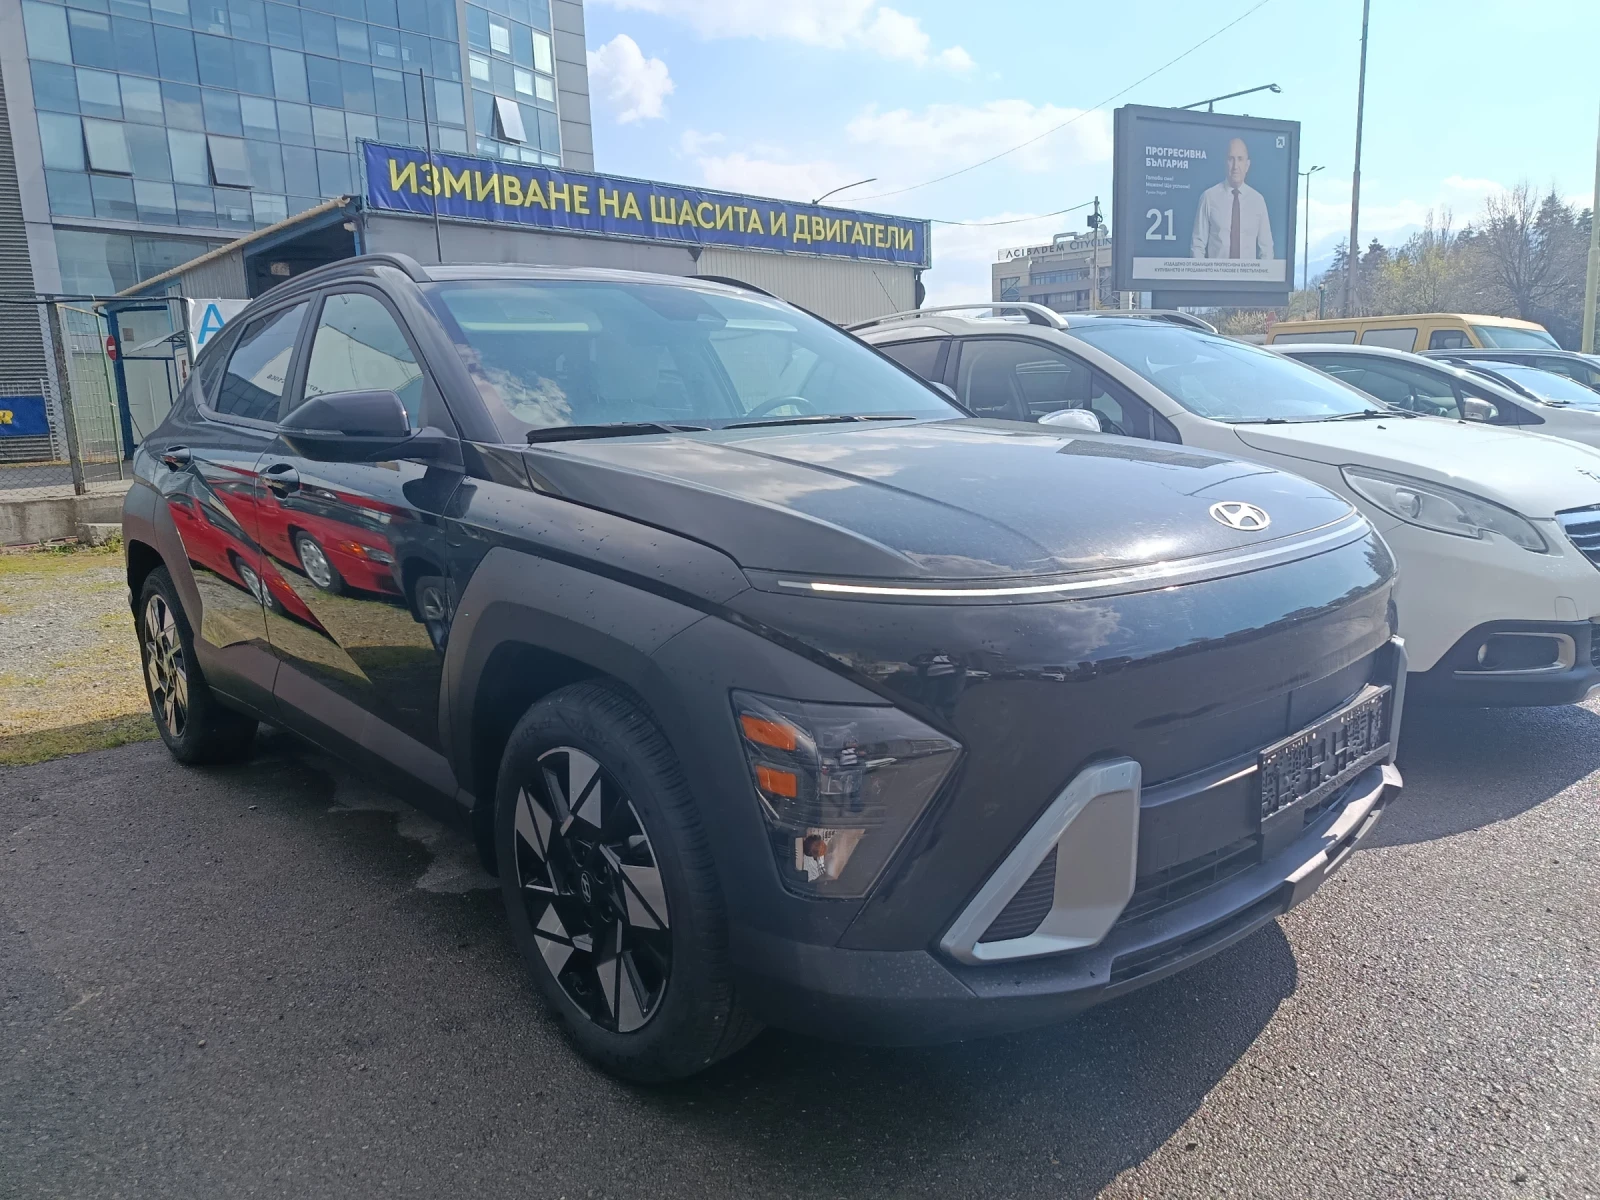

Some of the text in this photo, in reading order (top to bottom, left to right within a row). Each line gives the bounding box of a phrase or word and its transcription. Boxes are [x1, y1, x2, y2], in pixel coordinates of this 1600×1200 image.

[1145, 146, 1207, 159] ПРОГРЕСИВНА
[1145, 158, 1189, 169] БЪЛГАРИЯ
[388, 159, 914, 251] ИЗМИВАНЕ НА ШАСИТА И ДВИГАТЕЛИ
[1146, 208, 1176, 240] 21
